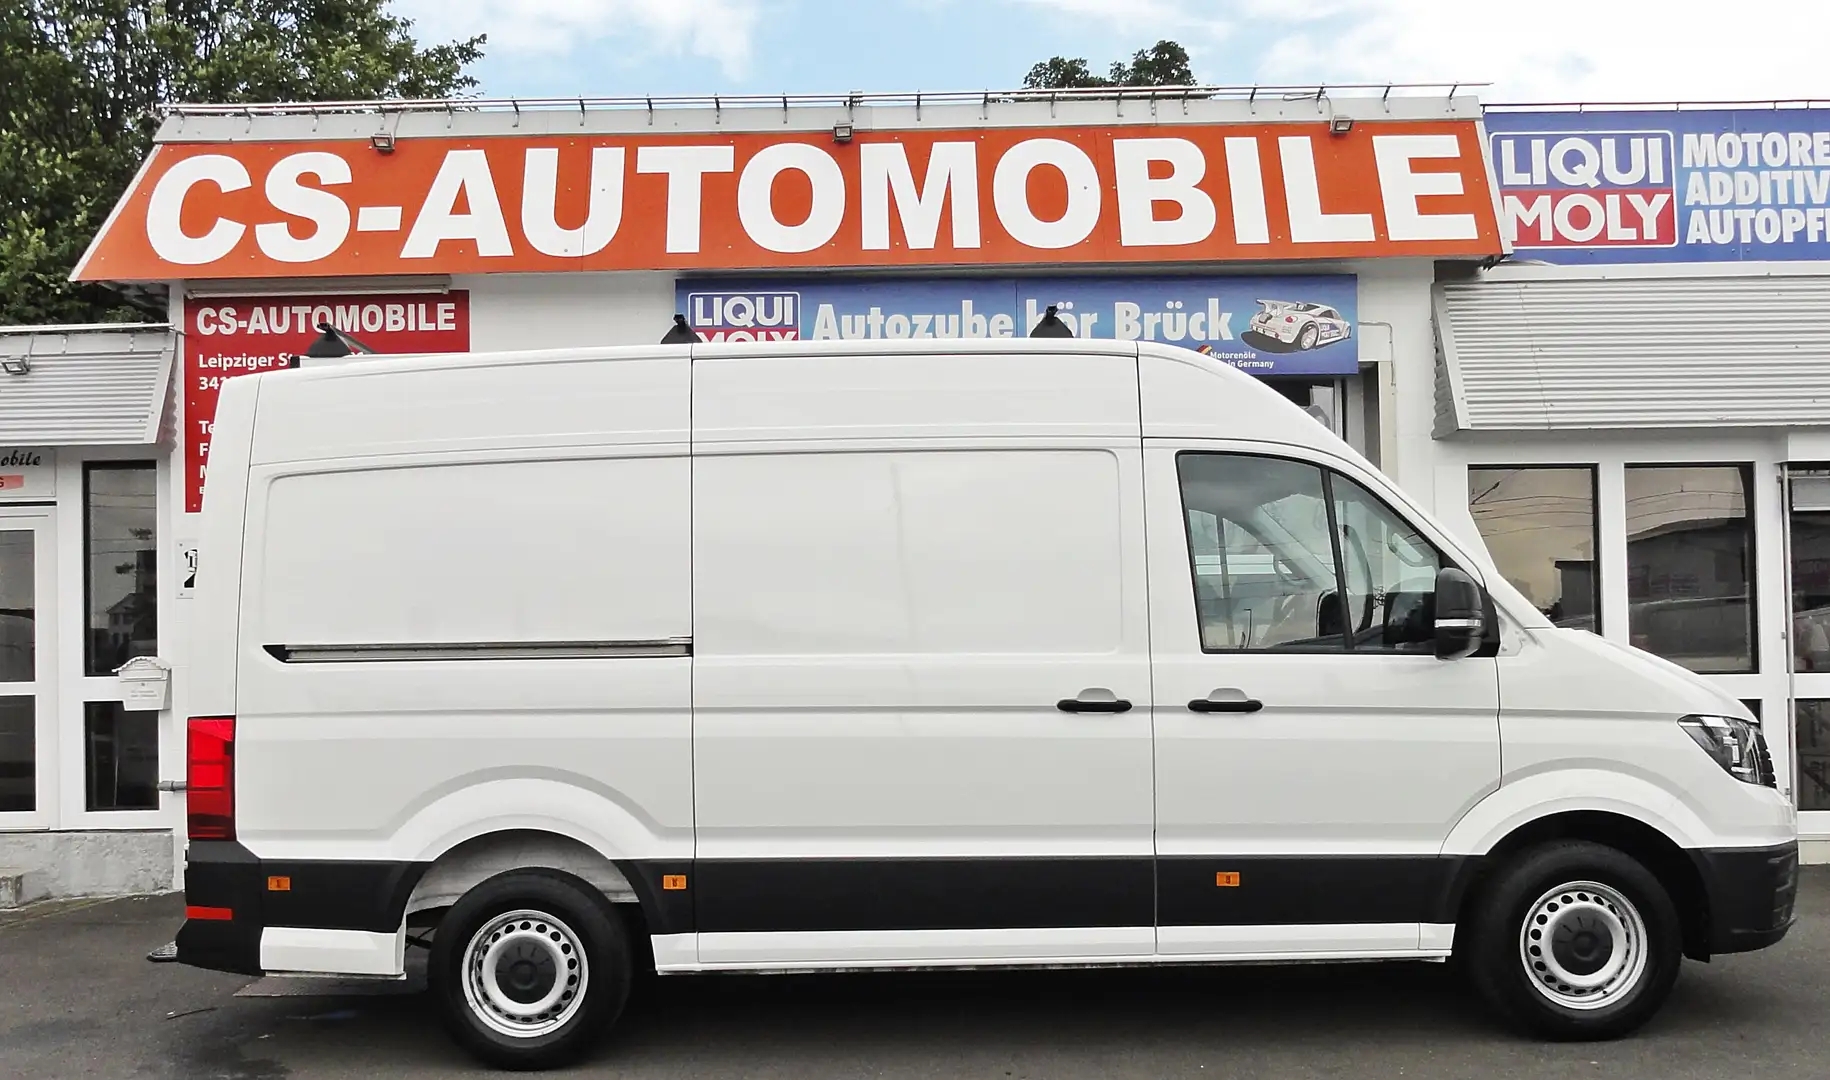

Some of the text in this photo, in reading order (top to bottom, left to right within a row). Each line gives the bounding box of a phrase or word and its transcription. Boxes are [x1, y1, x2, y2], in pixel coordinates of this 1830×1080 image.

[1501, 136, 1664, 188] LIQUI
[146, 134, 1479, 265] CS-AUTOMOBILE
[1685, 170, 1830, 205] ADDITIV
[1504, 193, 1673, 242] MOLY
[197, 304, 456, 335] CS-AUTOMOBILE
[695, 296, 794, 327] LIQUI
[1115, 298, 1234, 341] Brück
[199, 353, 274, 371] Leipziger
[1210, 351, 1256, 359] Motorenöle
[1237, 360, 1274, 369] Germany
